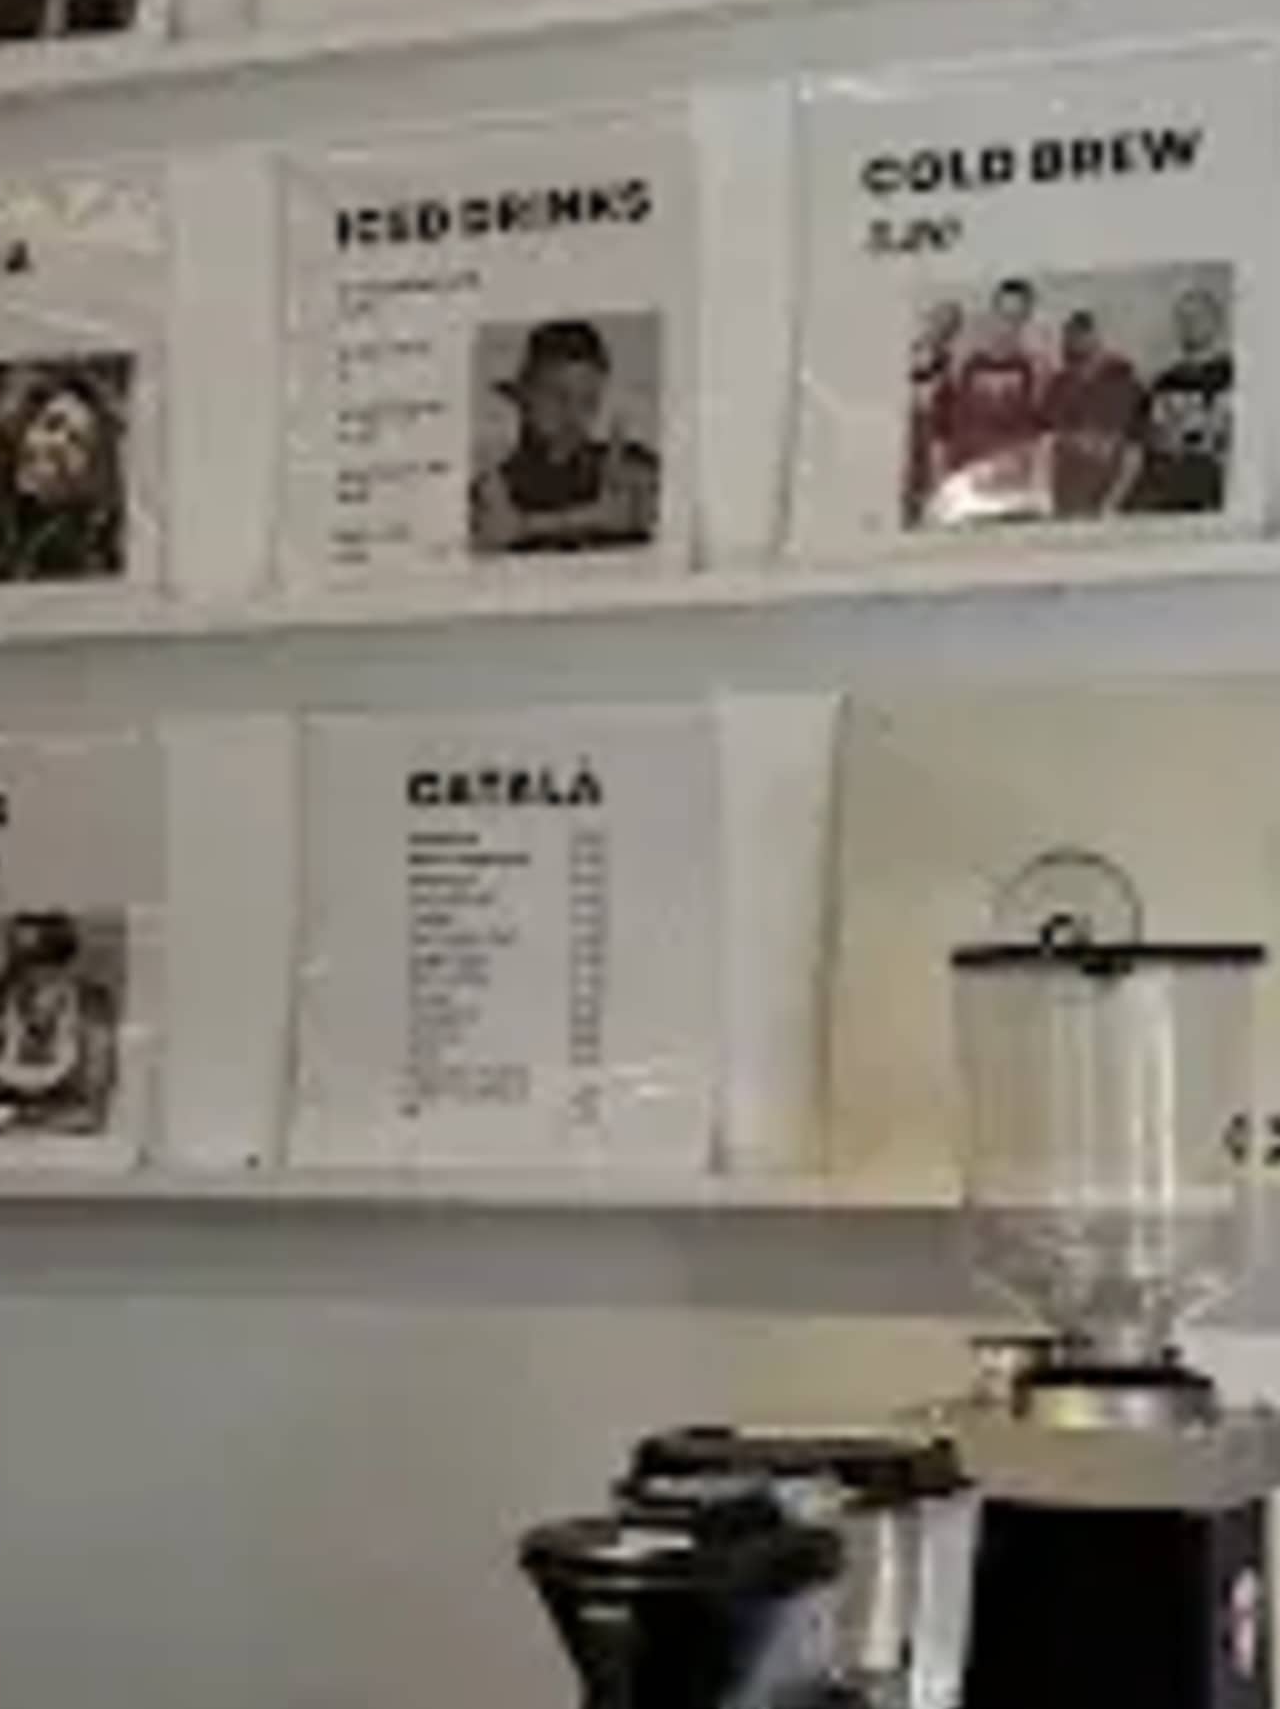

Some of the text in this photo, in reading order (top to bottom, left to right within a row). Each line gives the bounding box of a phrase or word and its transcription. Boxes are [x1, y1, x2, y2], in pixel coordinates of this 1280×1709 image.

[861, 128, 1201, 195] COLD BREW
[336, 179, 652, 248] ICED DRINKS
